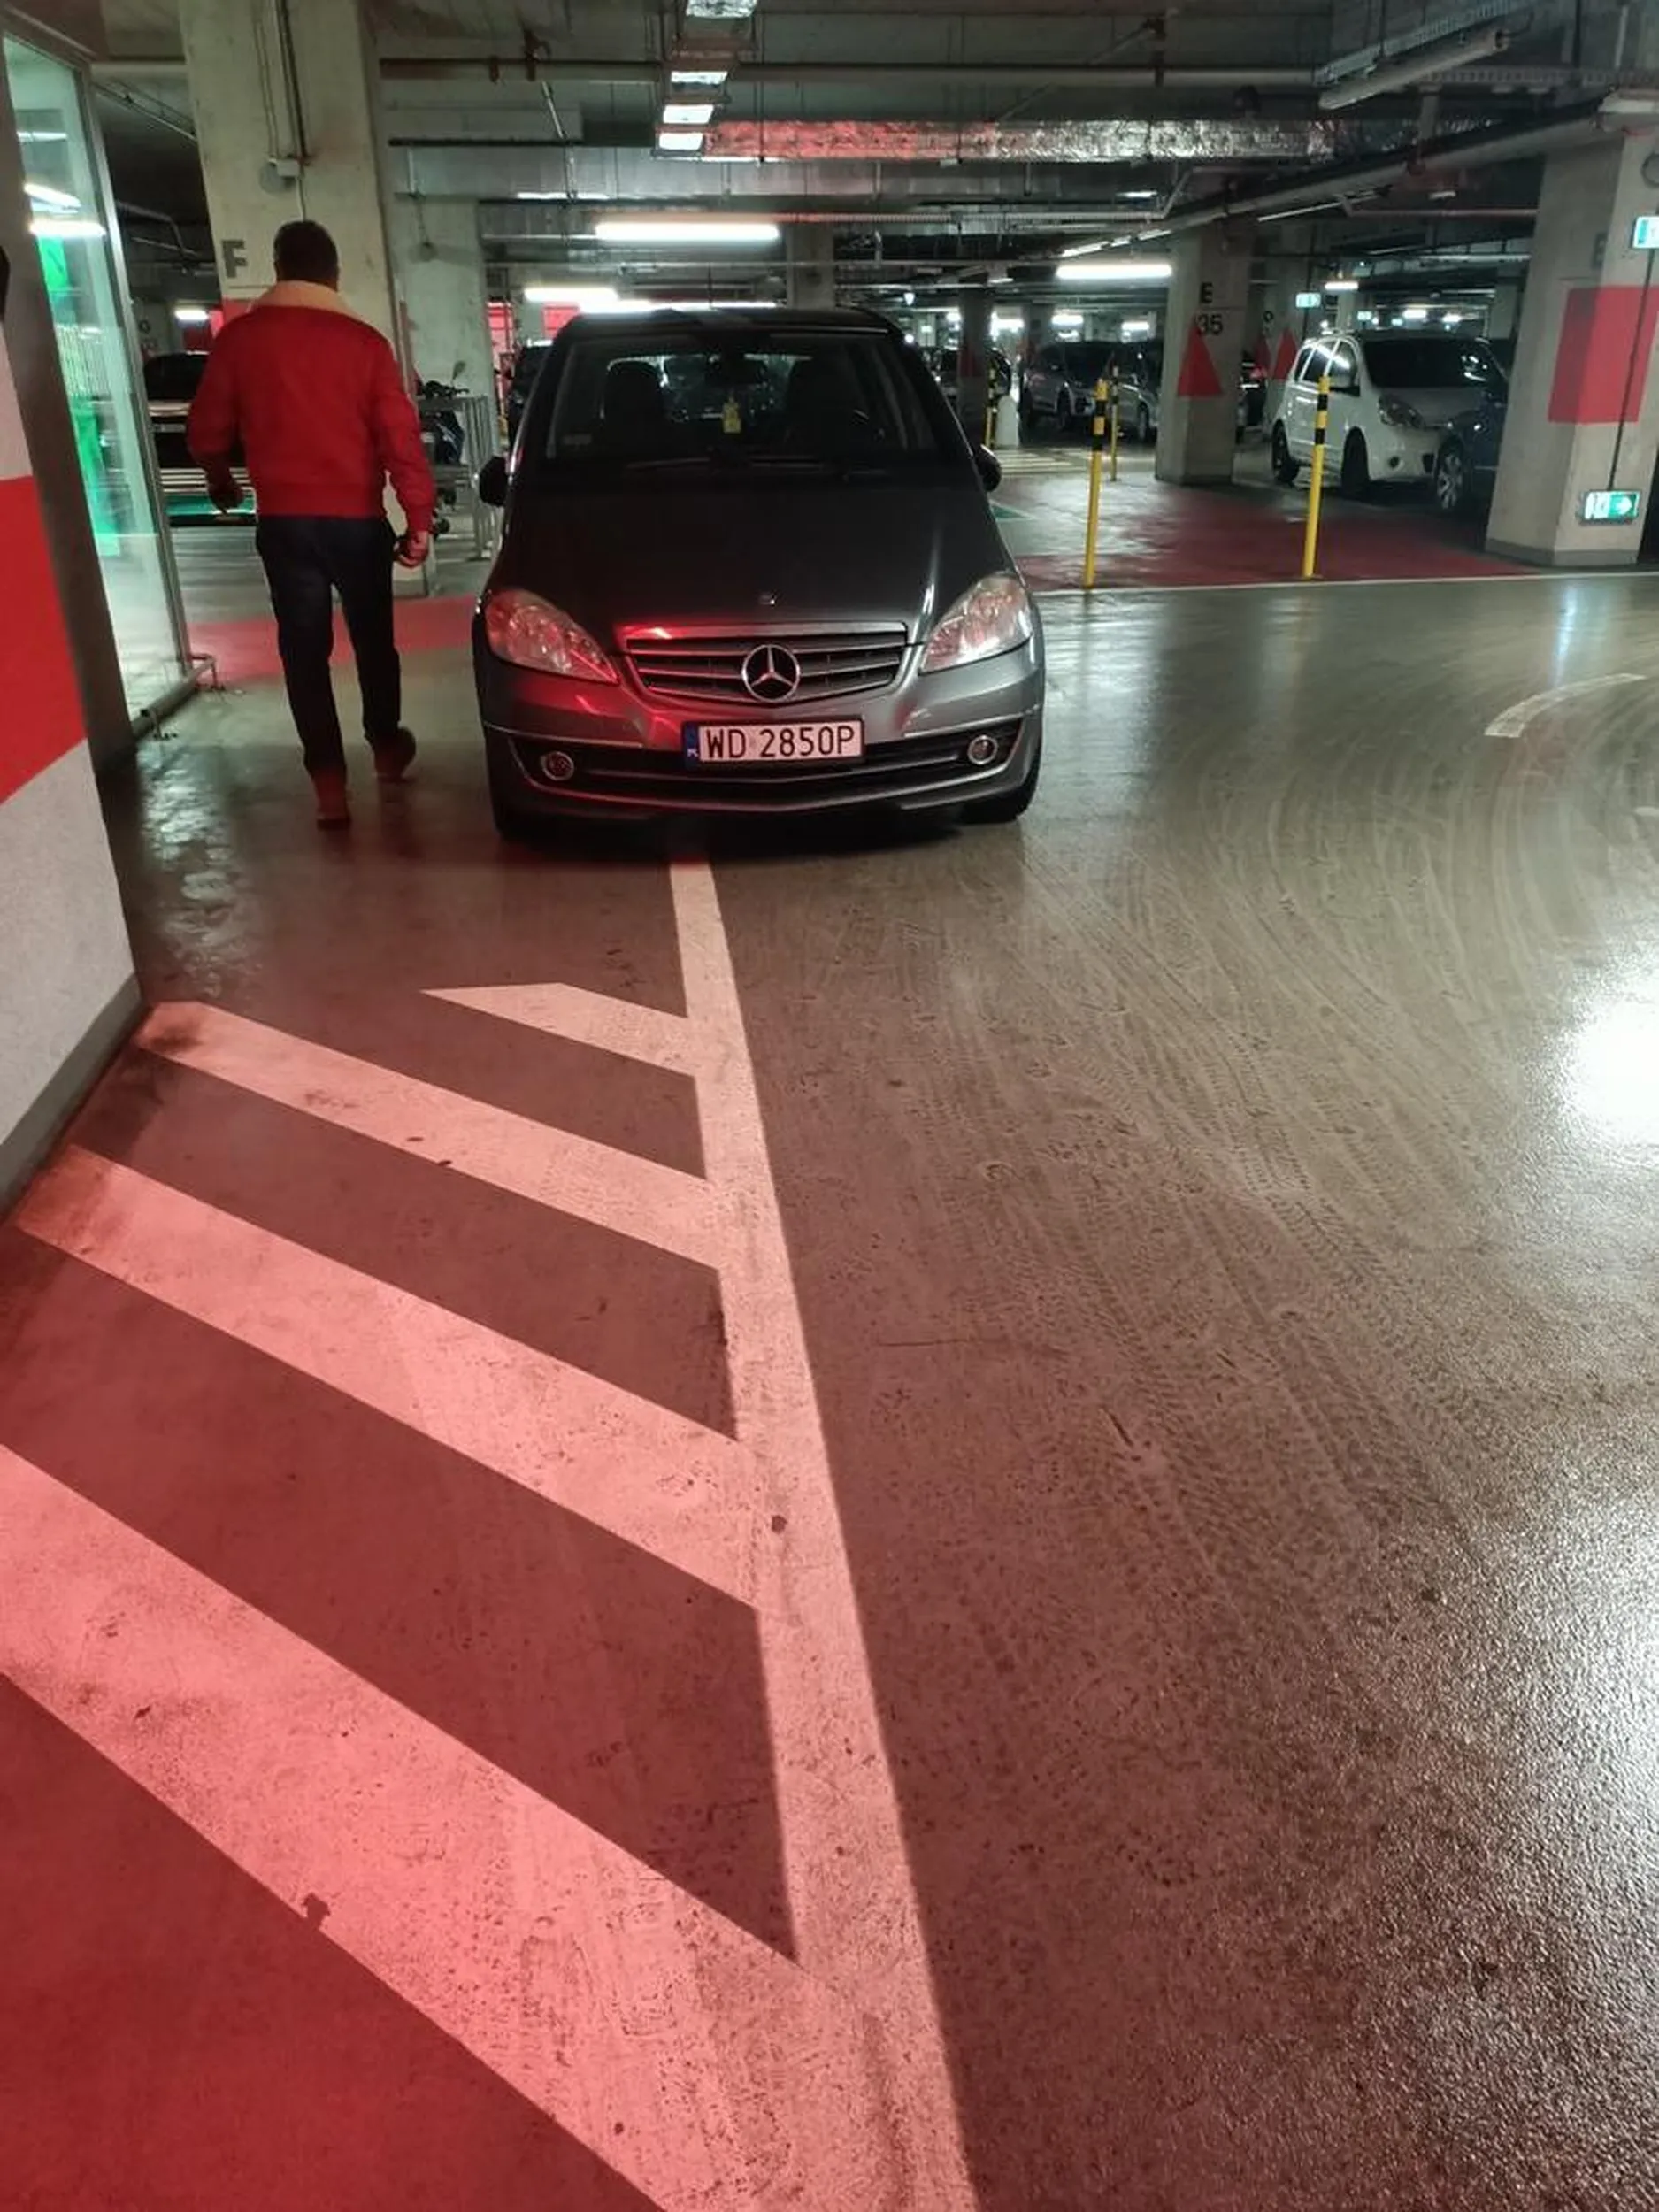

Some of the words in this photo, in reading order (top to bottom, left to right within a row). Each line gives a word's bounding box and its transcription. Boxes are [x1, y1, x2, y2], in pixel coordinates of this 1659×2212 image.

[221, 240, 247, 279] F
[1200, 282, 1213, 303] E
[706, 728, 747, 758] WD
[759, 726, 855, 757] 2850P
